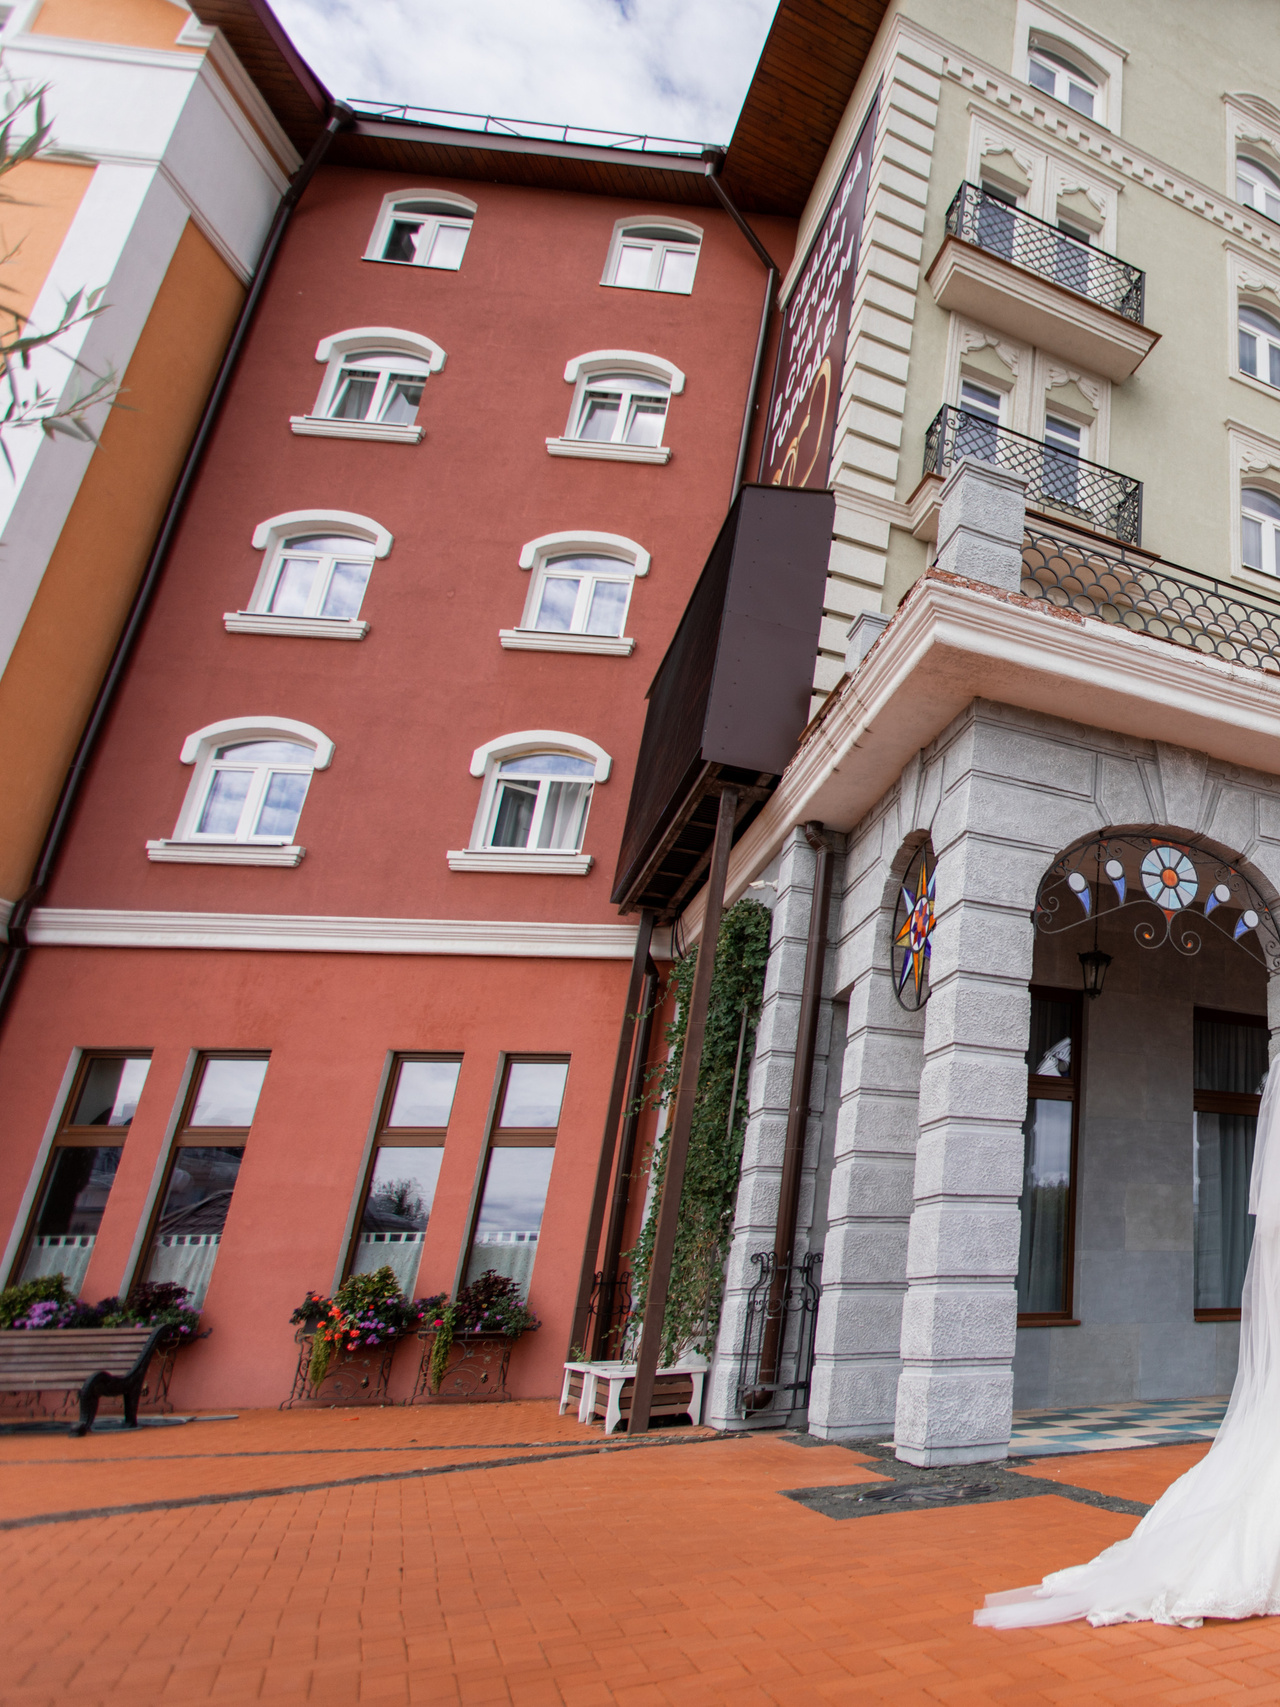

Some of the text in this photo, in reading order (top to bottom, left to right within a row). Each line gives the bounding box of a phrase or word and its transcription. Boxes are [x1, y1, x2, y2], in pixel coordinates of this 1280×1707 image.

[789, 151, 863, 329] СВАДЬБА
[789, 216, 847, 363] МЕЧТЫ
[770, 300, 840, 467] ГОРОДЕ!
[772, 233, 855, 430] В СТАРОМ
